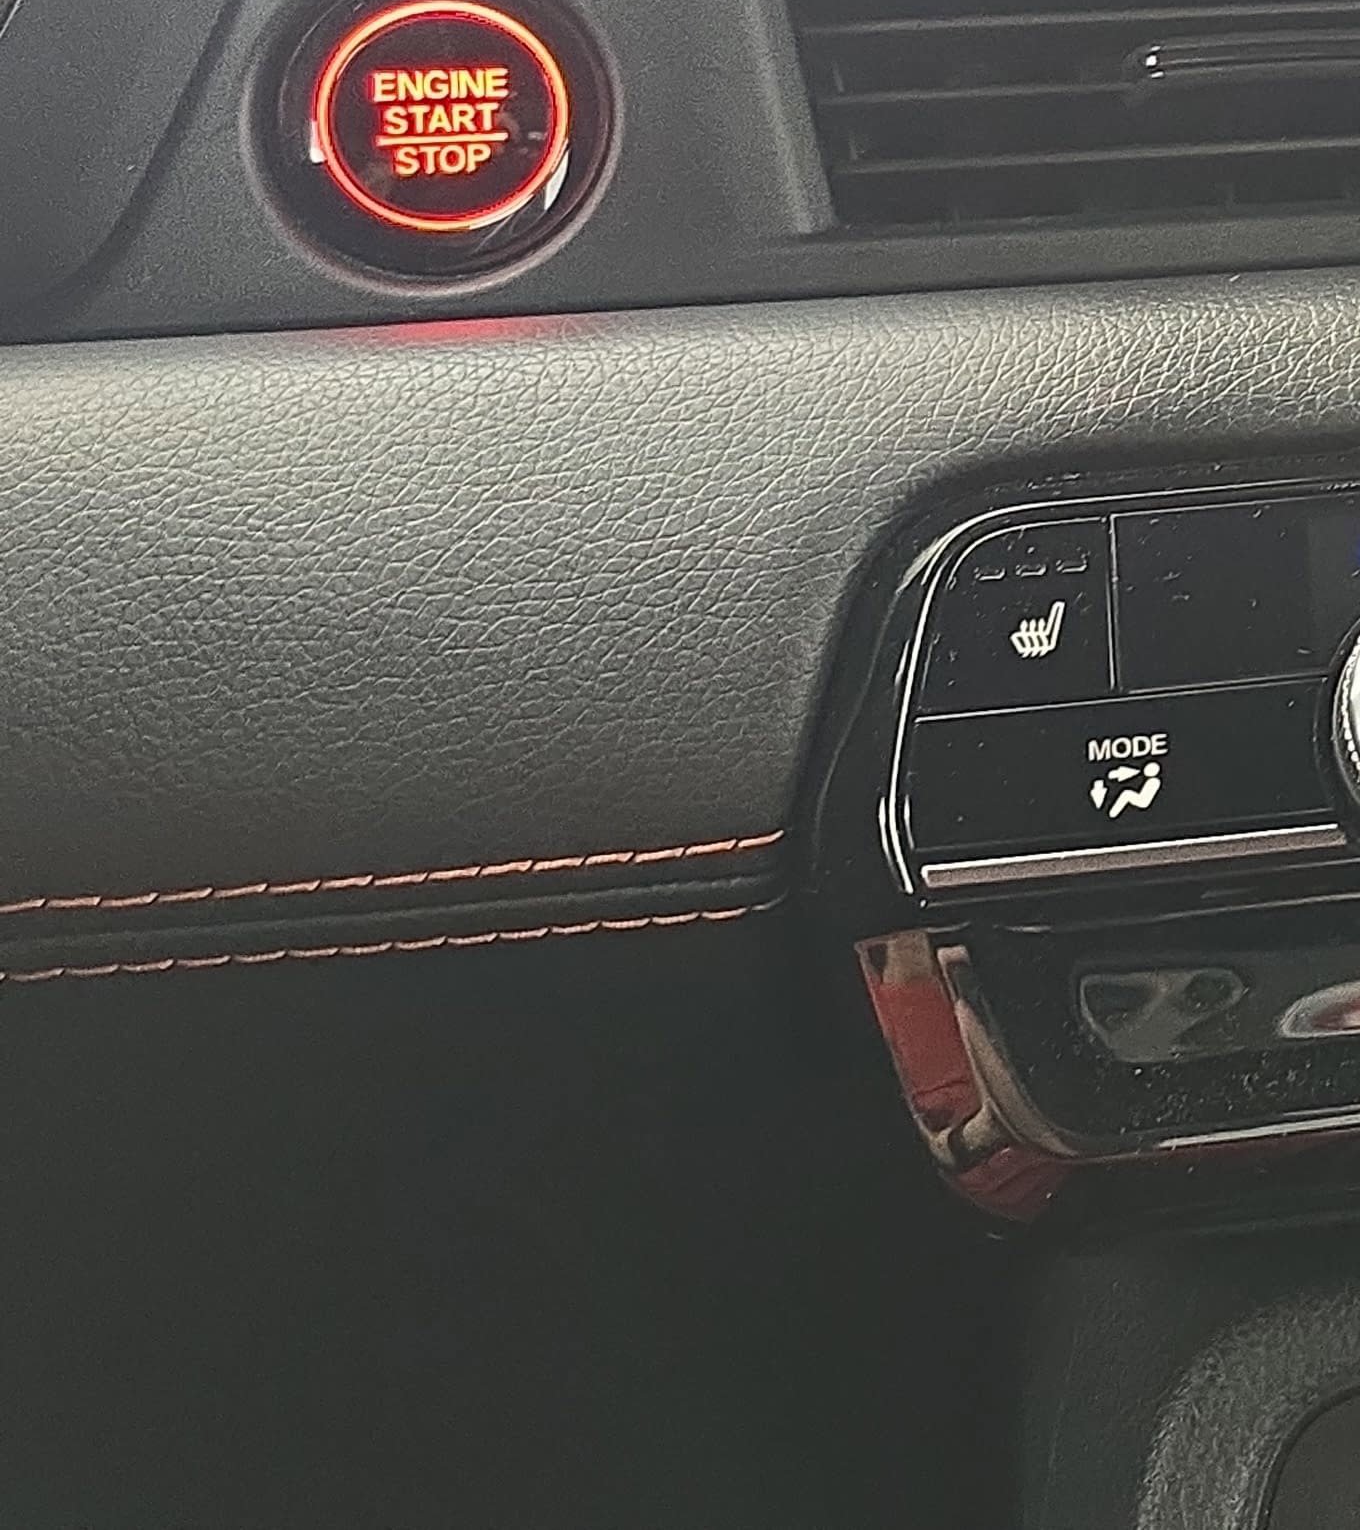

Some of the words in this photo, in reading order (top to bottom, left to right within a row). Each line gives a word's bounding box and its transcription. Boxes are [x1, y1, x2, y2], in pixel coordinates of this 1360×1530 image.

[373, 68, 508, 102] ENGINE
[384, 102, 499, 135] START
[395, 143, 491, 175] STOP
[1088, 734, 1168, 761] MODE
